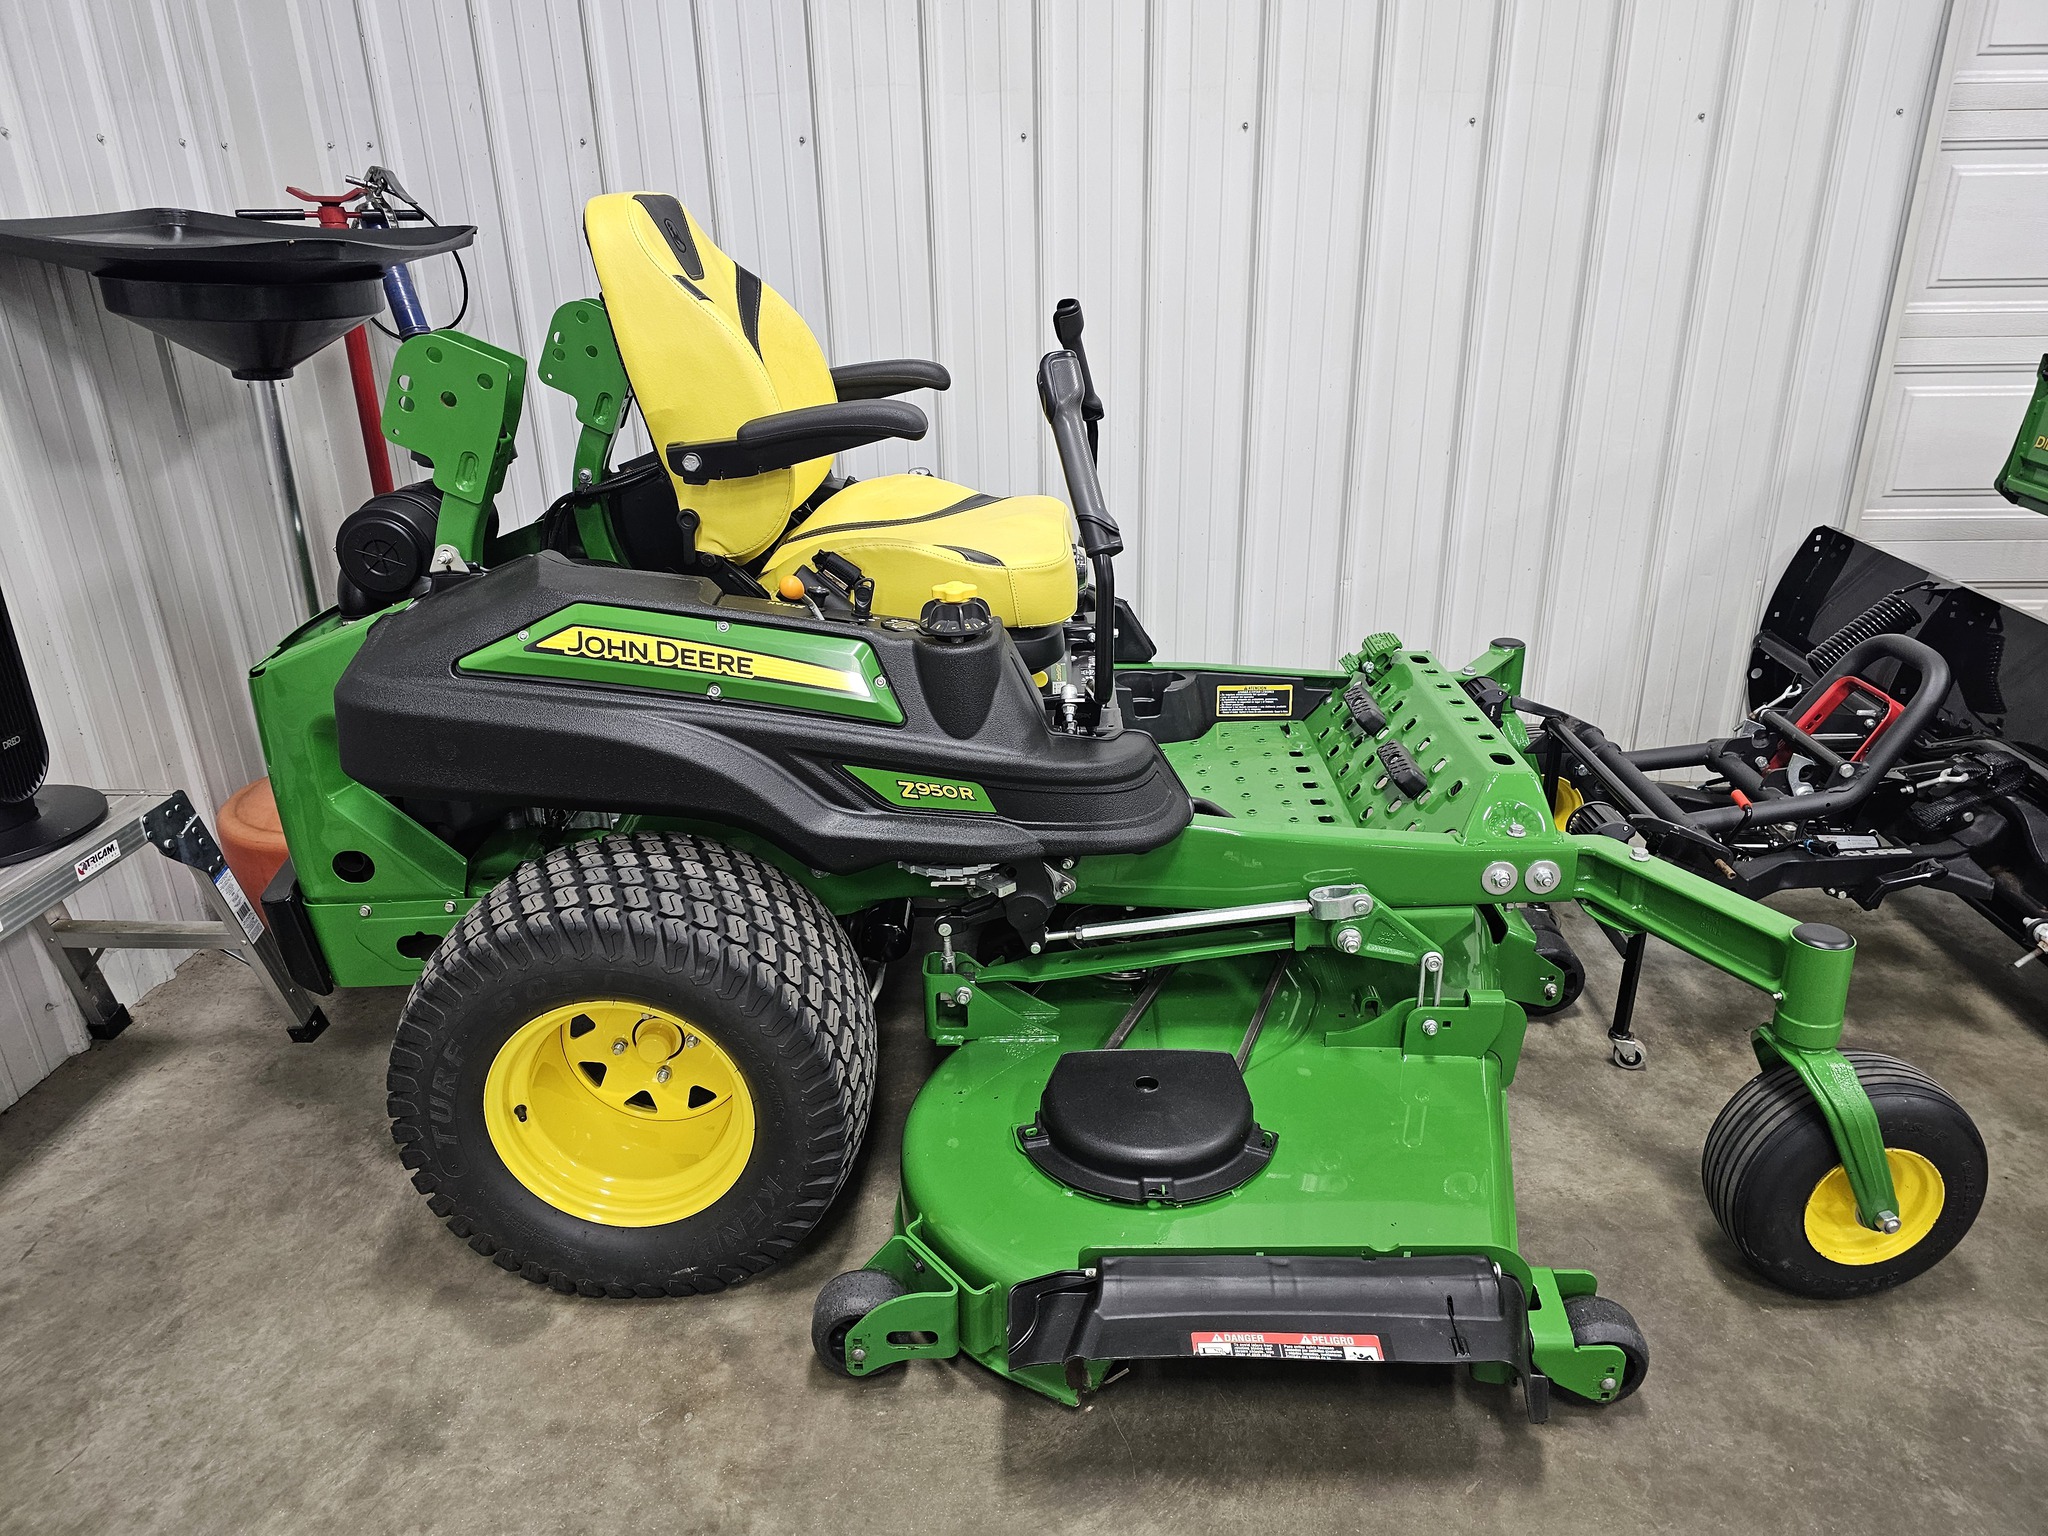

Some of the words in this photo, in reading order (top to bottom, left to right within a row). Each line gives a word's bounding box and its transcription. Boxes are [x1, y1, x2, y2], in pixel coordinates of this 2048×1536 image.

[567, 630, 648, 661] JOHN
[656, 642, 754, 675] DEERE
[2, 735, 21, 750] DREO
[85, 843, 116, 868] TRICAM
[428, 1037, 466, 1150] TURF
[1223, 1333, 1265, 1343] DANGER
[1311, 1335, 1355, 1346] PELIGRO
